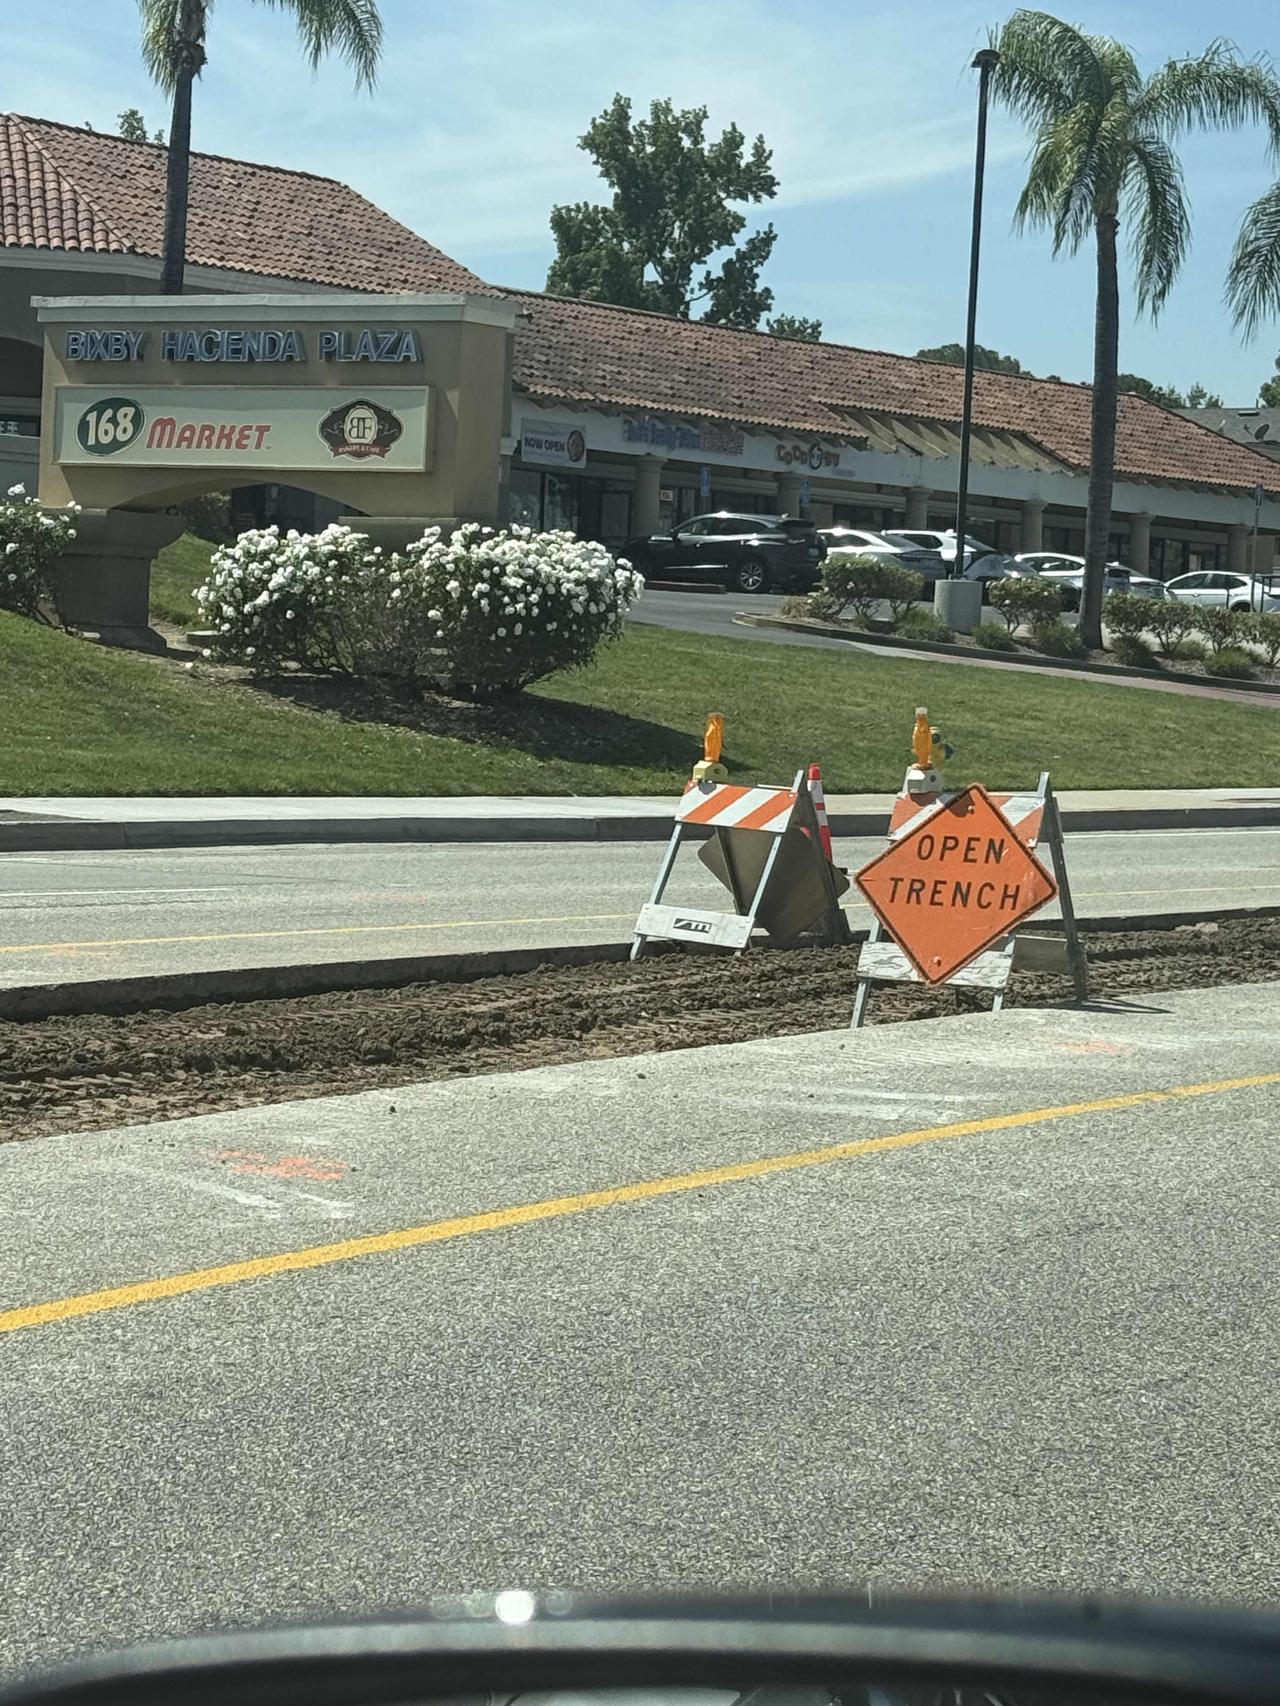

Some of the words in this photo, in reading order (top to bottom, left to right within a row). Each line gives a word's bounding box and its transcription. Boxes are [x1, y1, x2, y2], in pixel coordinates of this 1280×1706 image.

[66, 329, 143, 362] BIXBY
[161, 329, 303, 363] HACIENDA
[317, 329, 420, 363] PLAZA
[85, 406, 136, 447] 168
[524, 436, 543, 449] NOW
[544, 439, 566, 452] OPEN
[917, 834, 1004, 864] OPEN
[889, 877, 1021, 911] TRENCH
